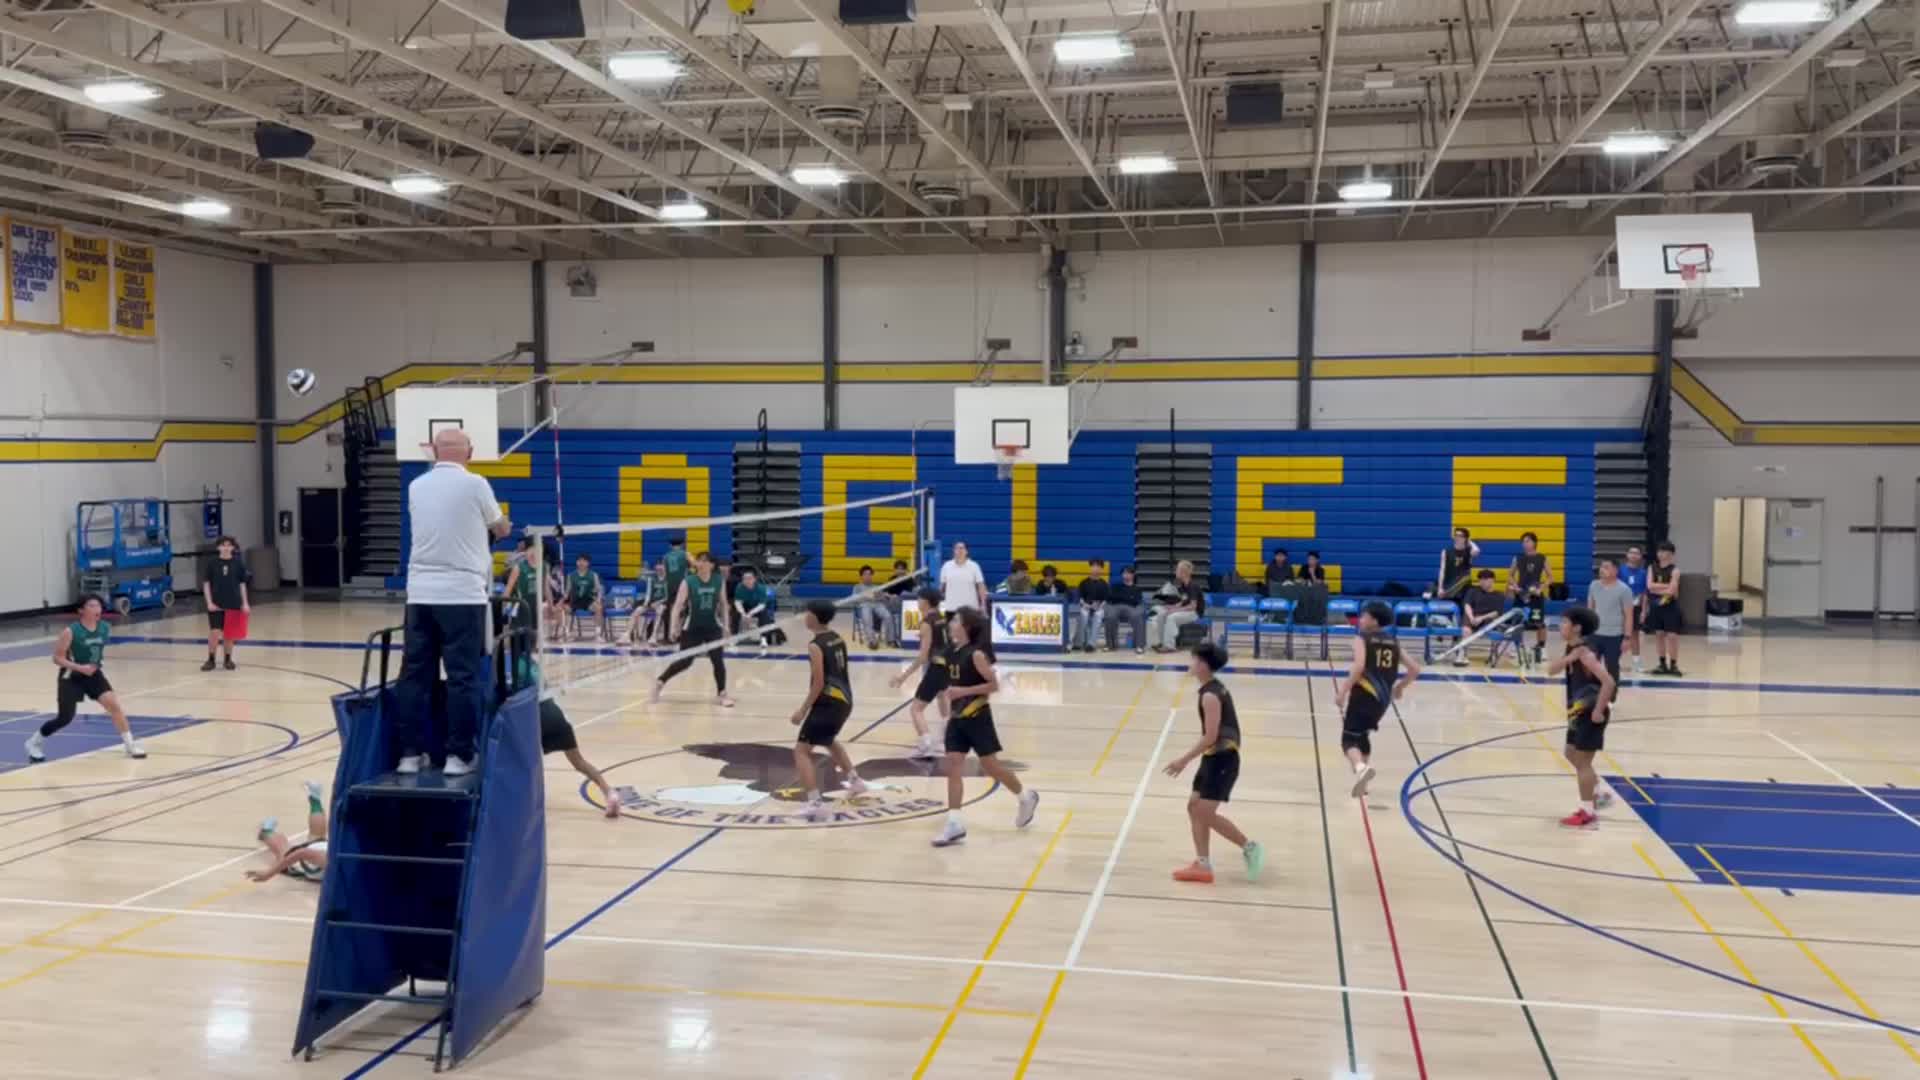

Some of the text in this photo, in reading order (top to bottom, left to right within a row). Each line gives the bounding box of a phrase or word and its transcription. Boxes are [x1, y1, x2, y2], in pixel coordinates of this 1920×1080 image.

[1015, 610, 1061, 635] EAGLES
[1375, 648, 1393, 668] 13
[713, 811, 786, 824] THE
